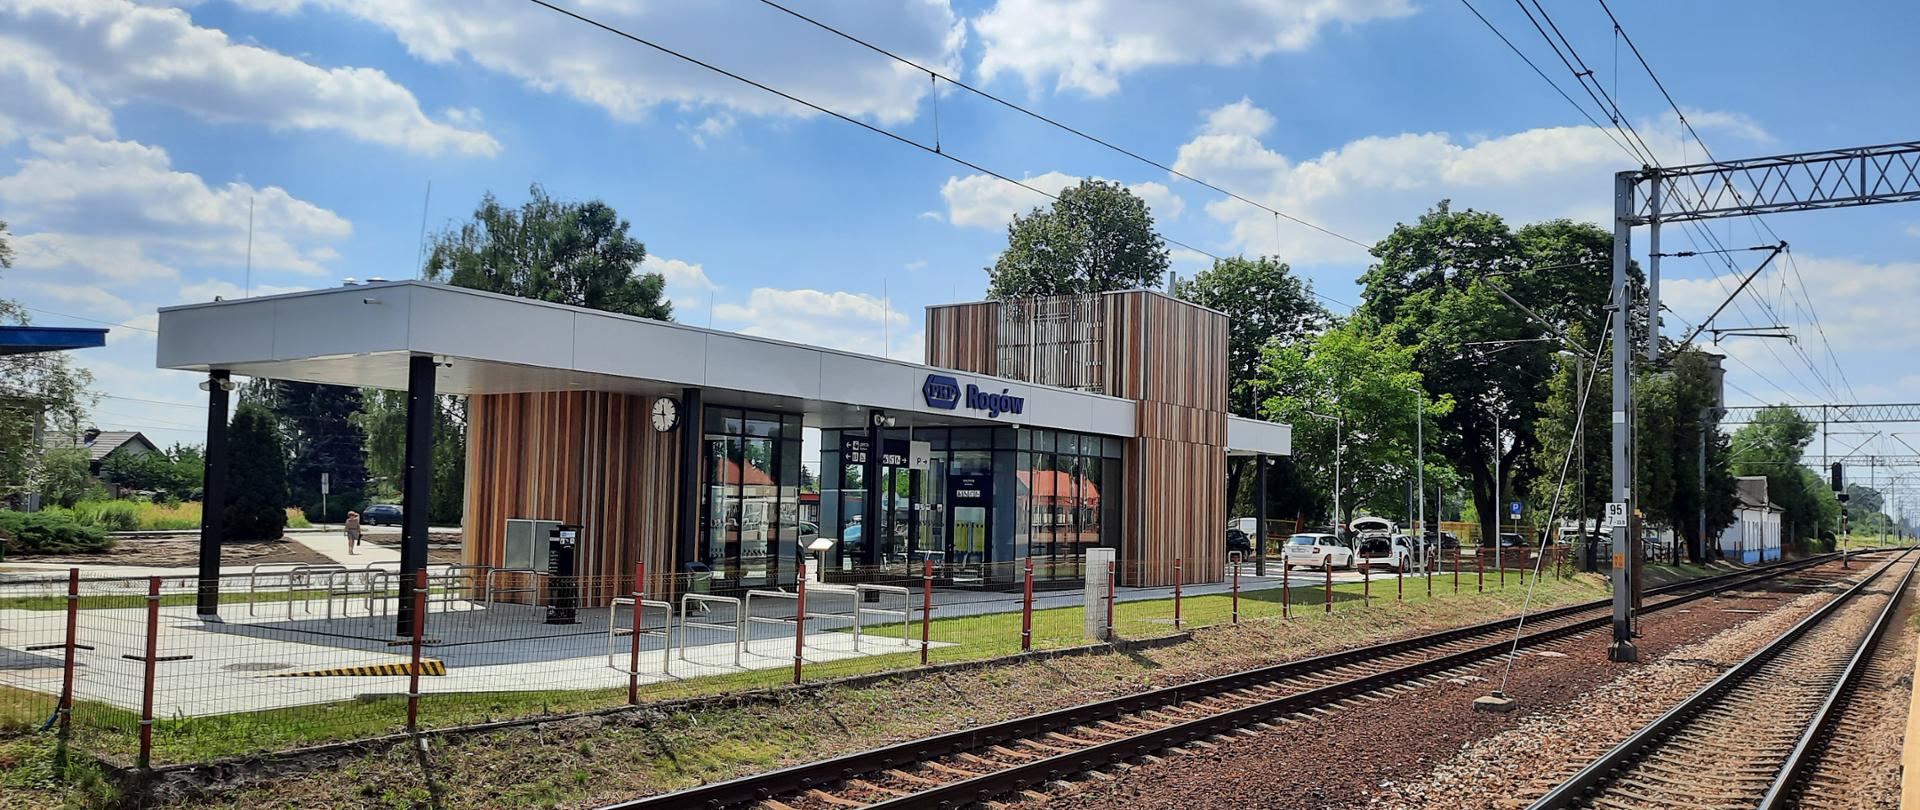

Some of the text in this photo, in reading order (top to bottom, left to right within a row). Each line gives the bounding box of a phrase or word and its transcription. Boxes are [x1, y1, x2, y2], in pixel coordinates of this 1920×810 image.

[929, 383, 958, 401] PKP
[966, 384, 1025, 418] Rogów
[1512, 503, 1519, 512] P
[1610, 504, 1623, 515] 95
